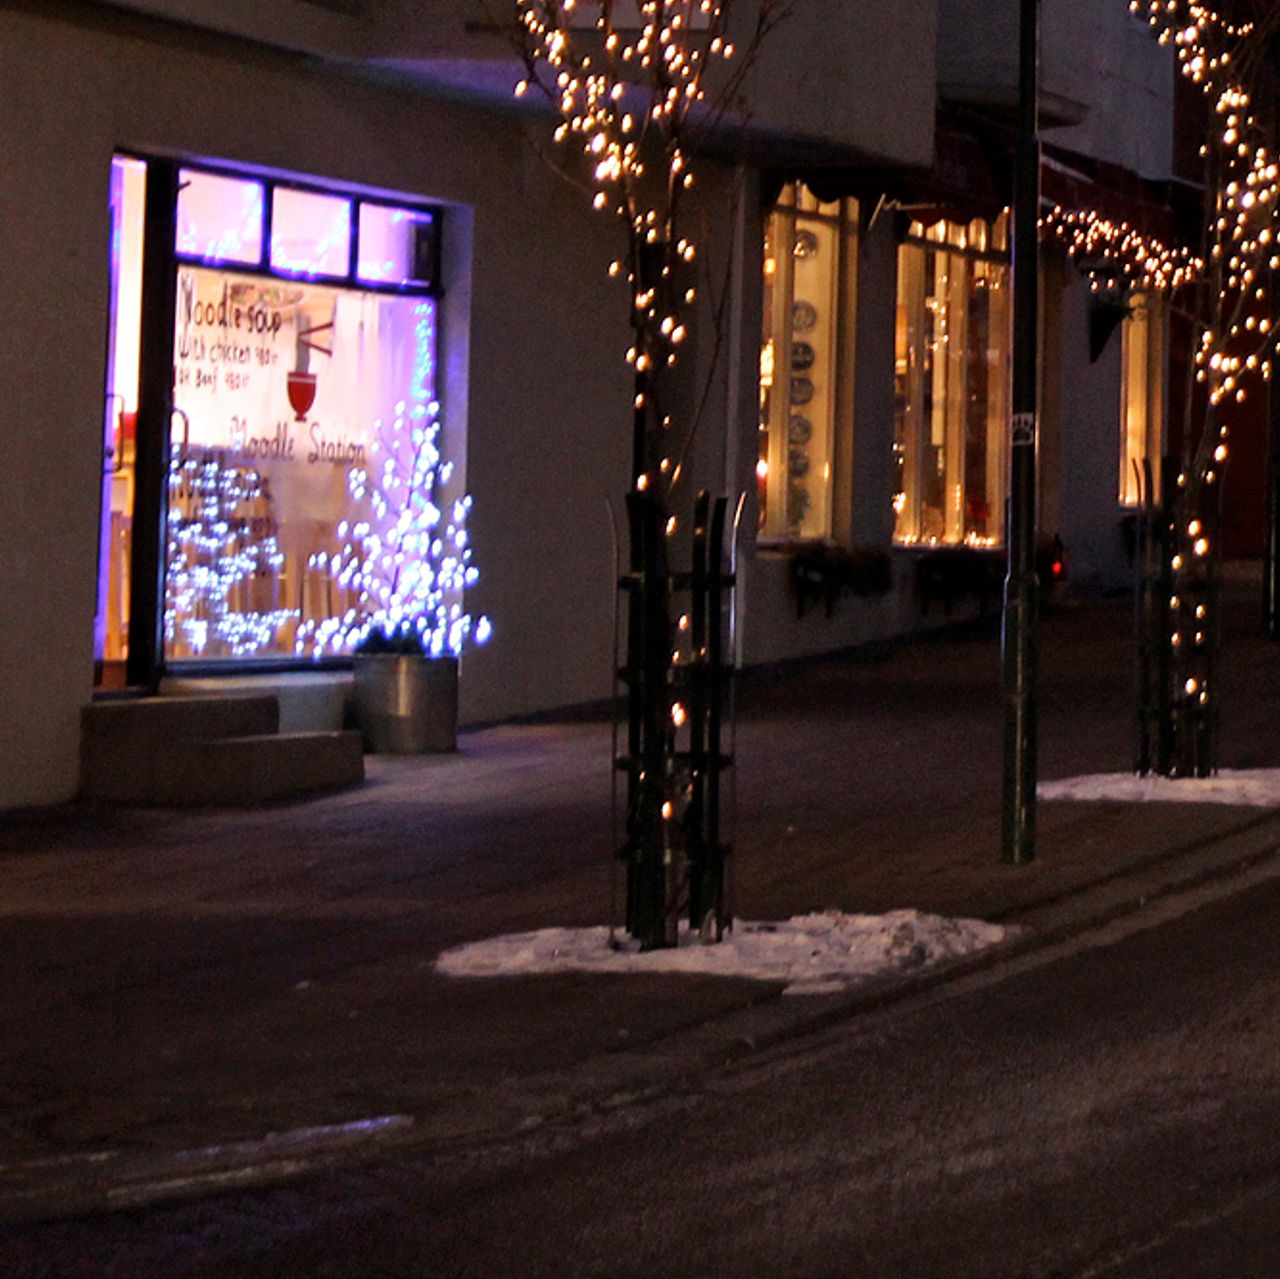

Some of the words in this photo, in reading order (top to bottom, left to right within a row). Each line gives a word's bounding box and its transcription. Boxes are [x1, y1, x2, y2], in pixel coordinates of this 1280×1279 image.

[247, 305, 282, 341] soup
[230, 415, 295, 462] Noodle
[308, 421, 367, 464] Station
